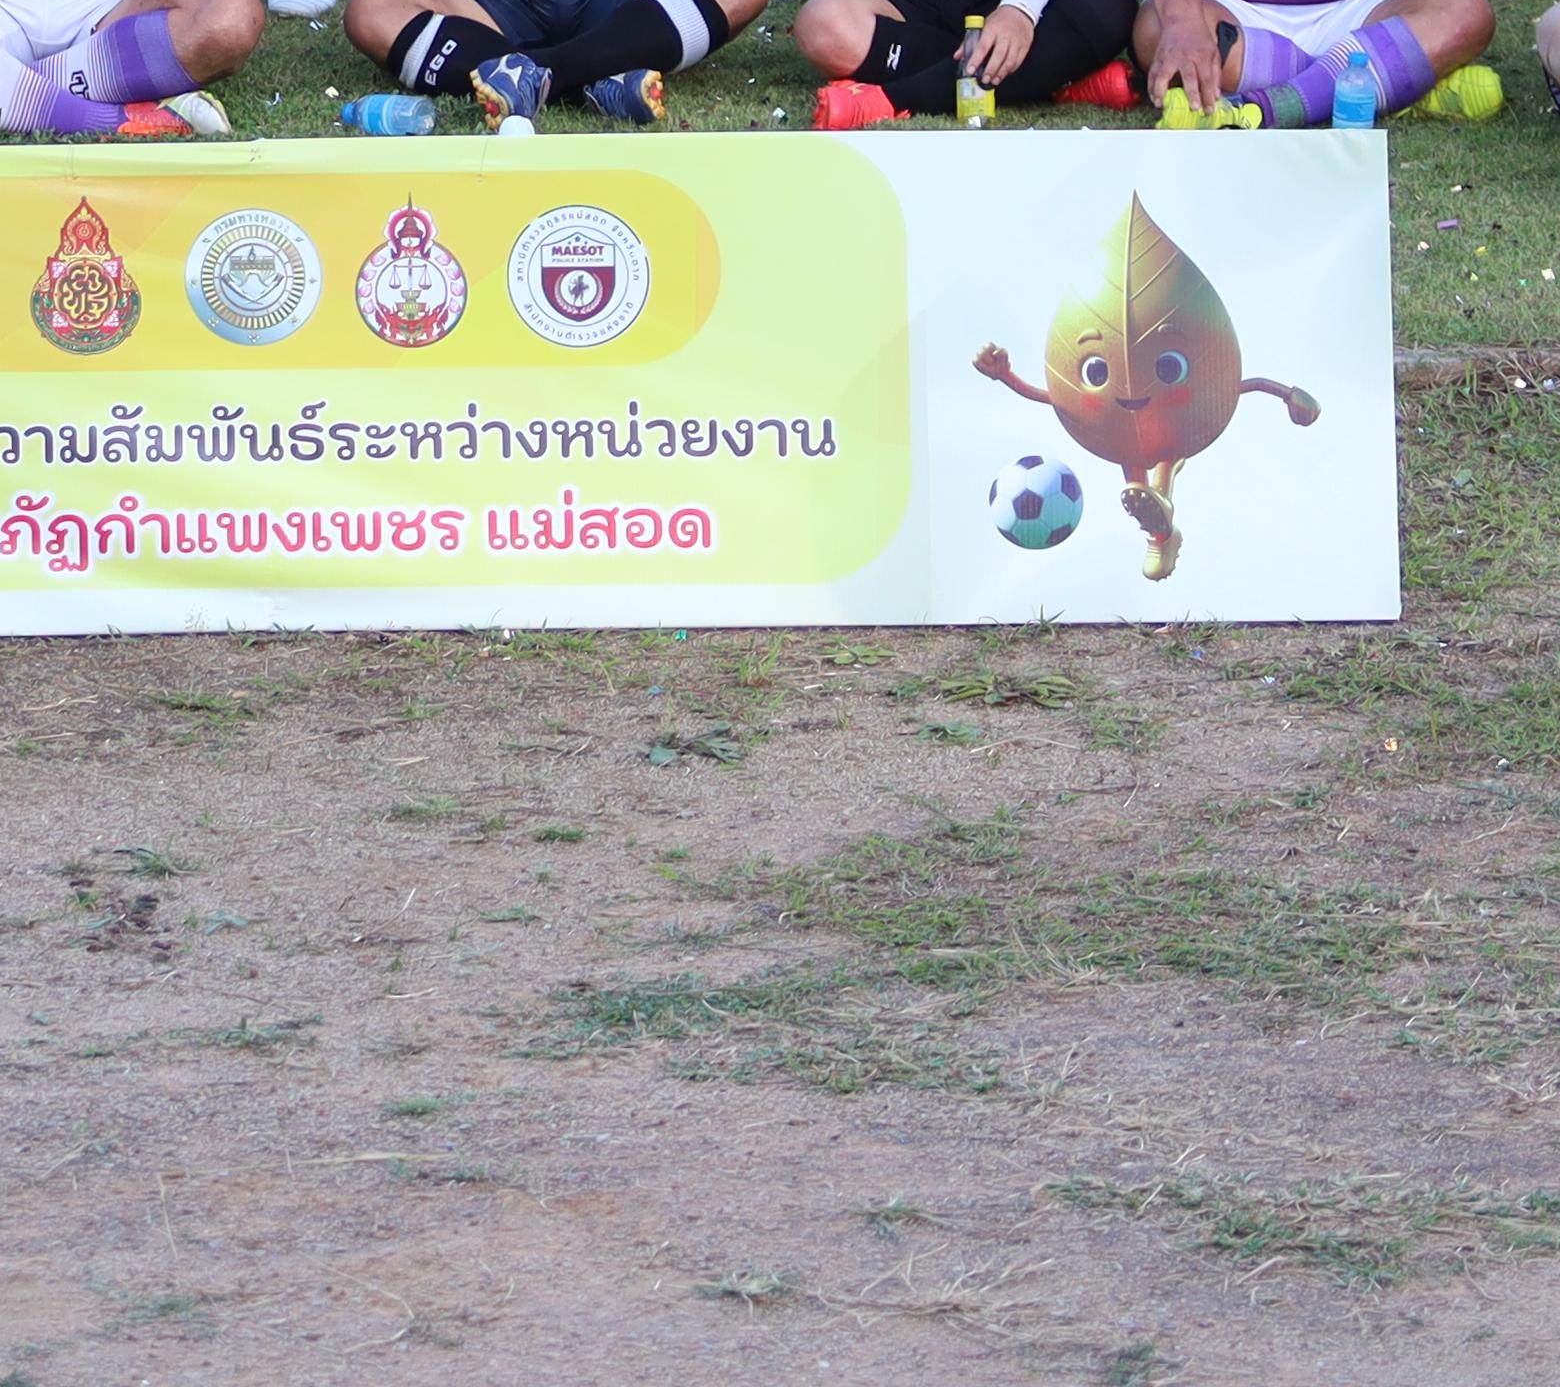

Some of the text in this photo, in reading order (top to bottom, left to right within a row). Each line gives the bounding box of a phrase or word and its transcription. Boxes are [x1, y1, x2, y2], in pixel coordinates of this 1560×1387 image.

[424, 38, 459, 86] EGO
[551, 245, 605, 257] MAESOT
[486, 489, 713, 552] แม่สอด
